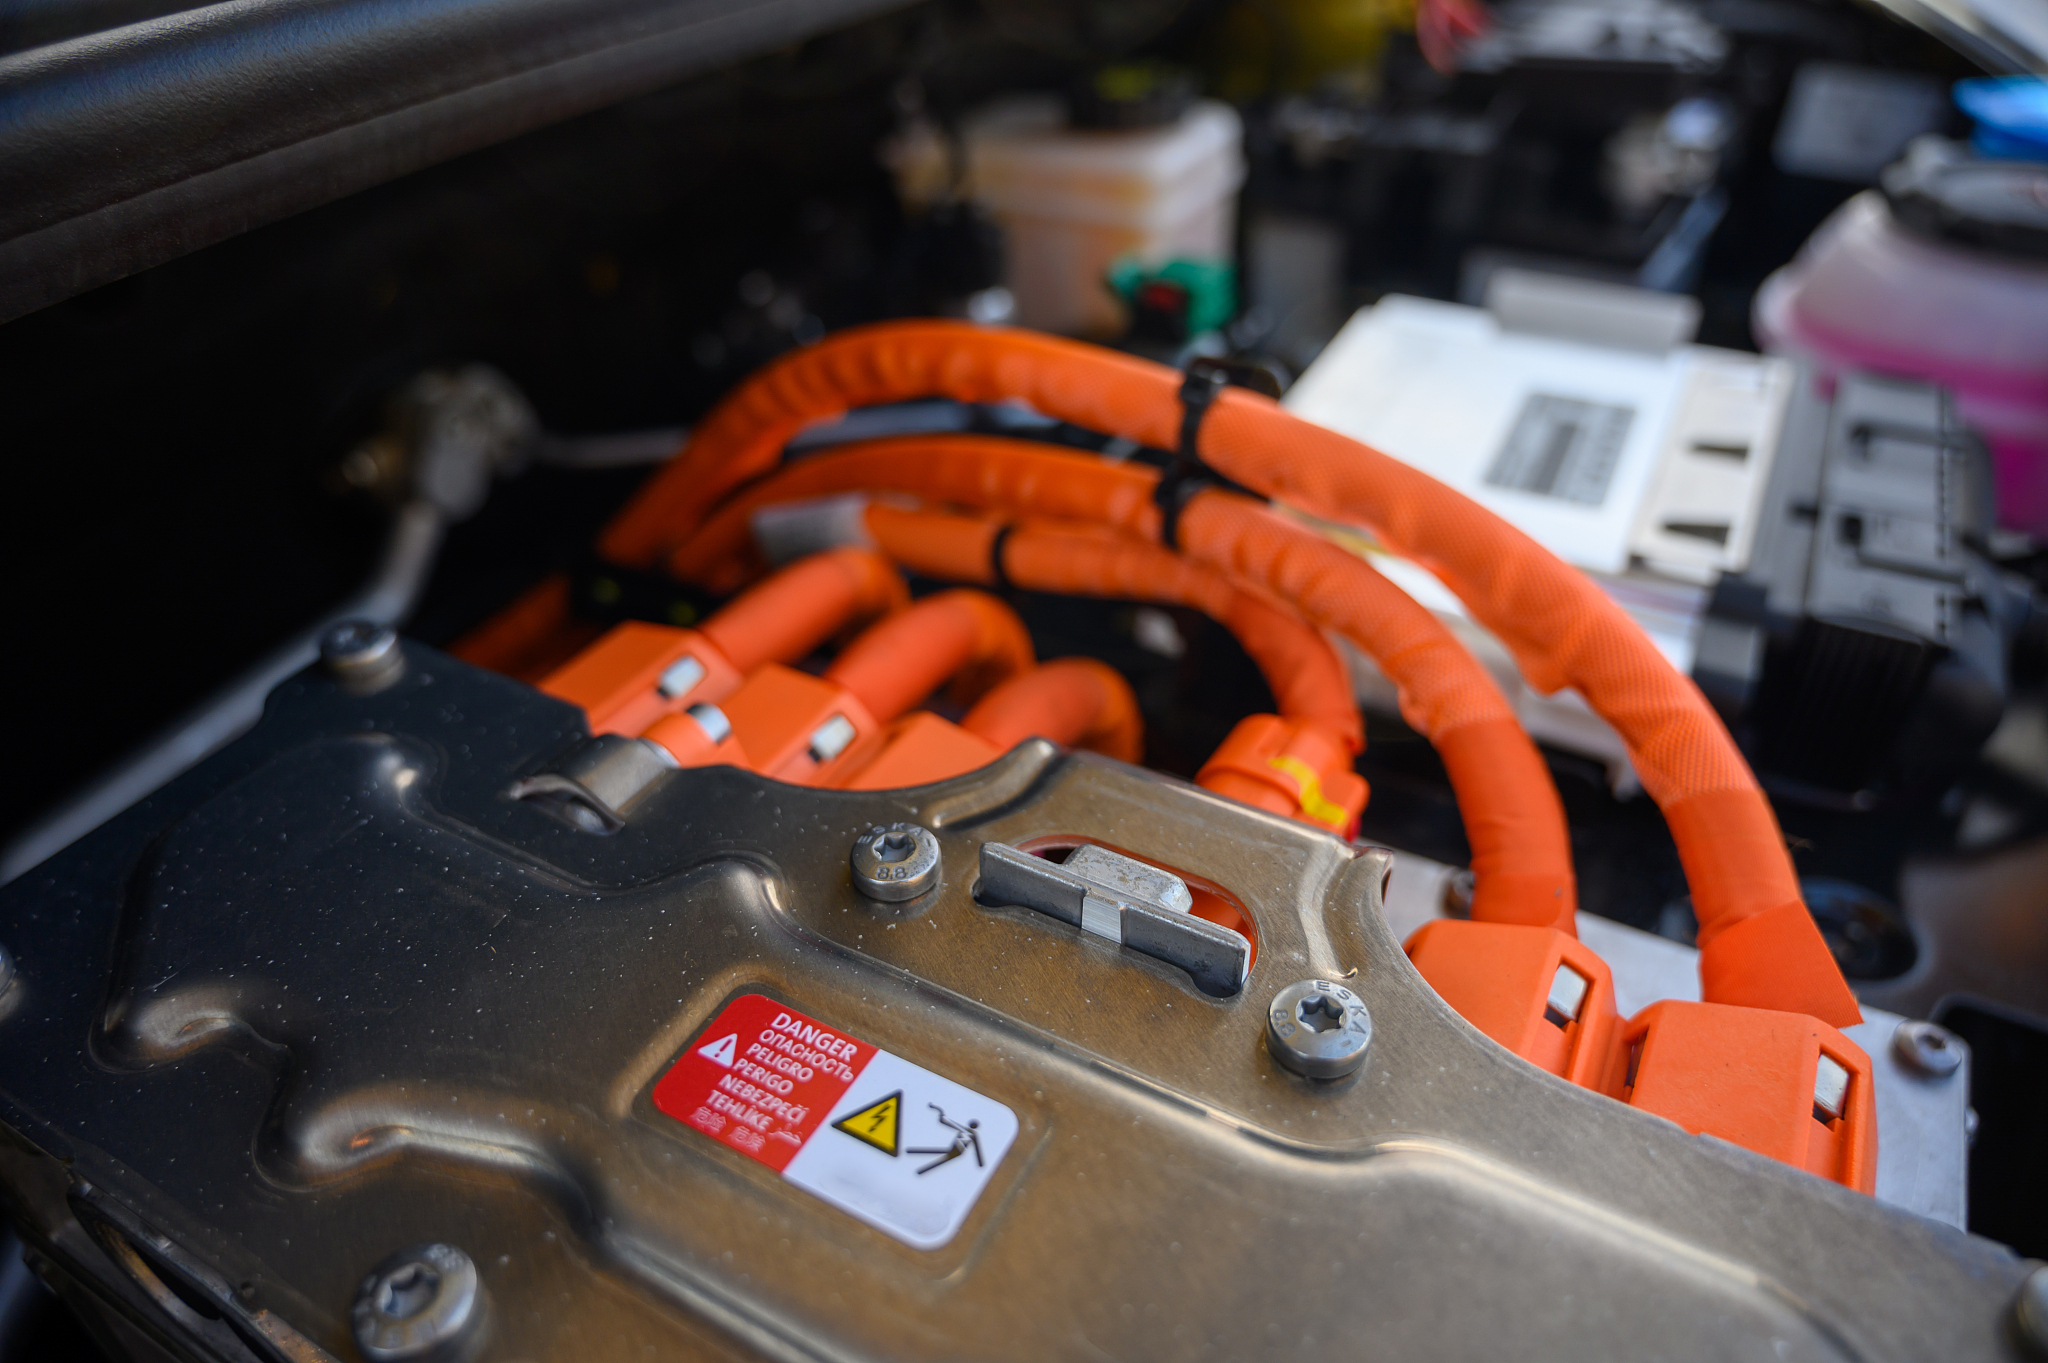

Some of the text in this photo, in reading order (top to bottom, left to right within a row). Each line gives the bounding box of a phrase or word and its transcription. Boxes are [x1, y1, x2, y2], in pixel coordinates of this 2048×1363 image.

[1316, 980, 1367, 1034] ESKA
[746, 1042, 814, 1082] PELIGRO
[758, 1029, 855, 1083] ОПАСНОСТЬ
[771, 1012, 857, 1062] DANGER
[717, 1073, 810, 1125] NEBEZPEČÍ
[733, 1058, 794, 1095] PERIGO
